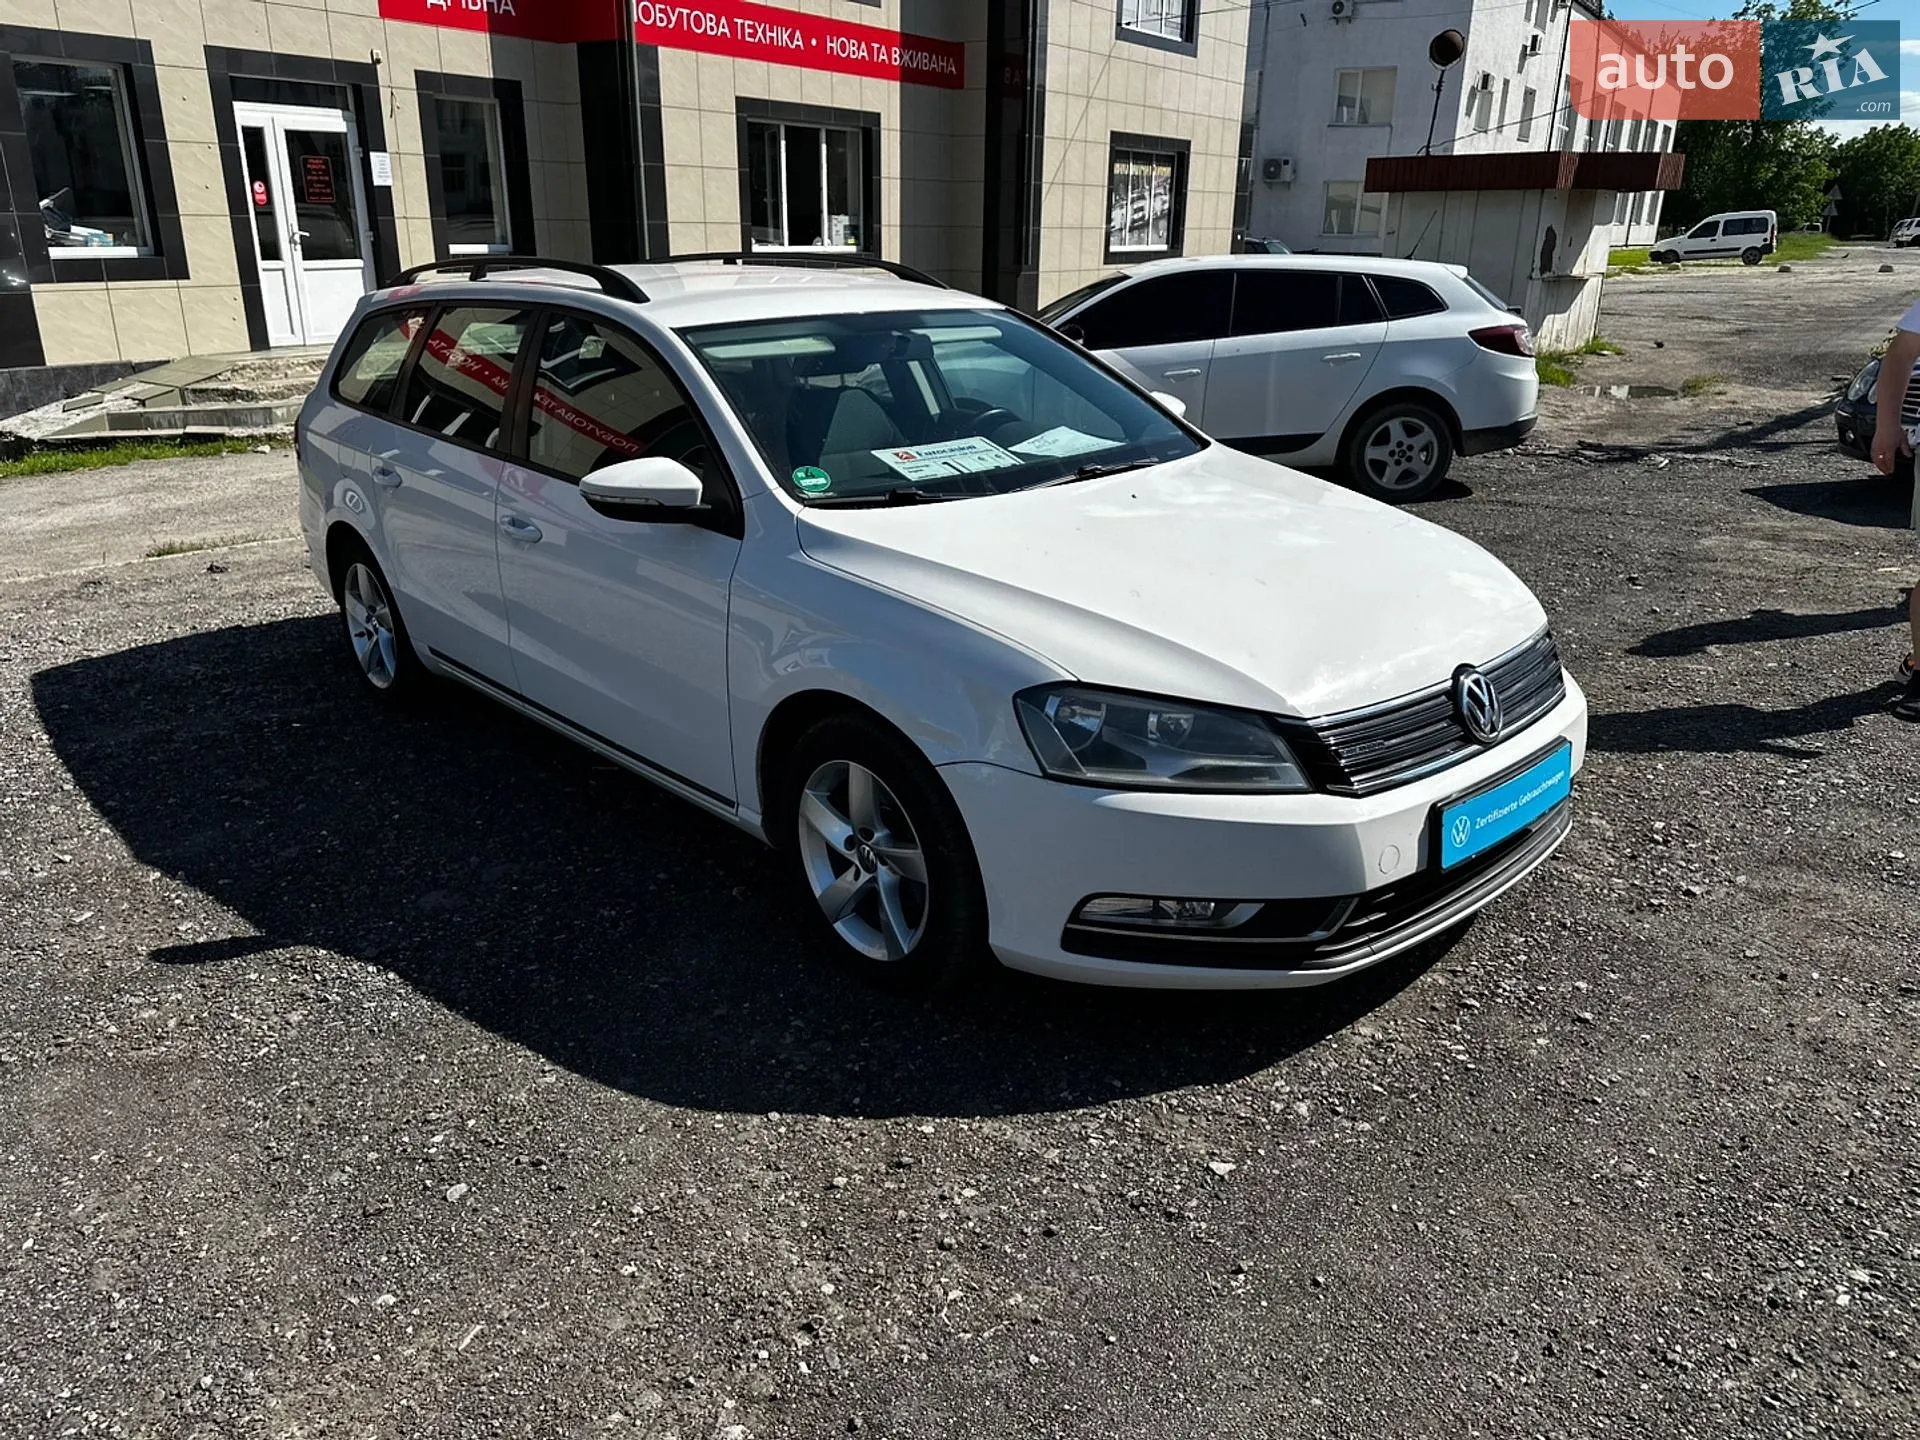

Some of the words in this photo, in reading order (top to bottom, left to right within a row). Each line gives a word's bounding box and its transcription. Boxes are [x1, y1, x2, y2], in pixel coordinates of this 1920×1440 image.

[733, 18, 805, 51] ТЕХНІКА
[826, 35, 869, 61] НОВА
[871, 42, 889, 64] ТА
[891, 47, 957, 75] ВЖИВАНА
[1475, 801, 1518, 830] Zertifizierte
[1518, 770, 1565, 806] Gebrauchtwagen
